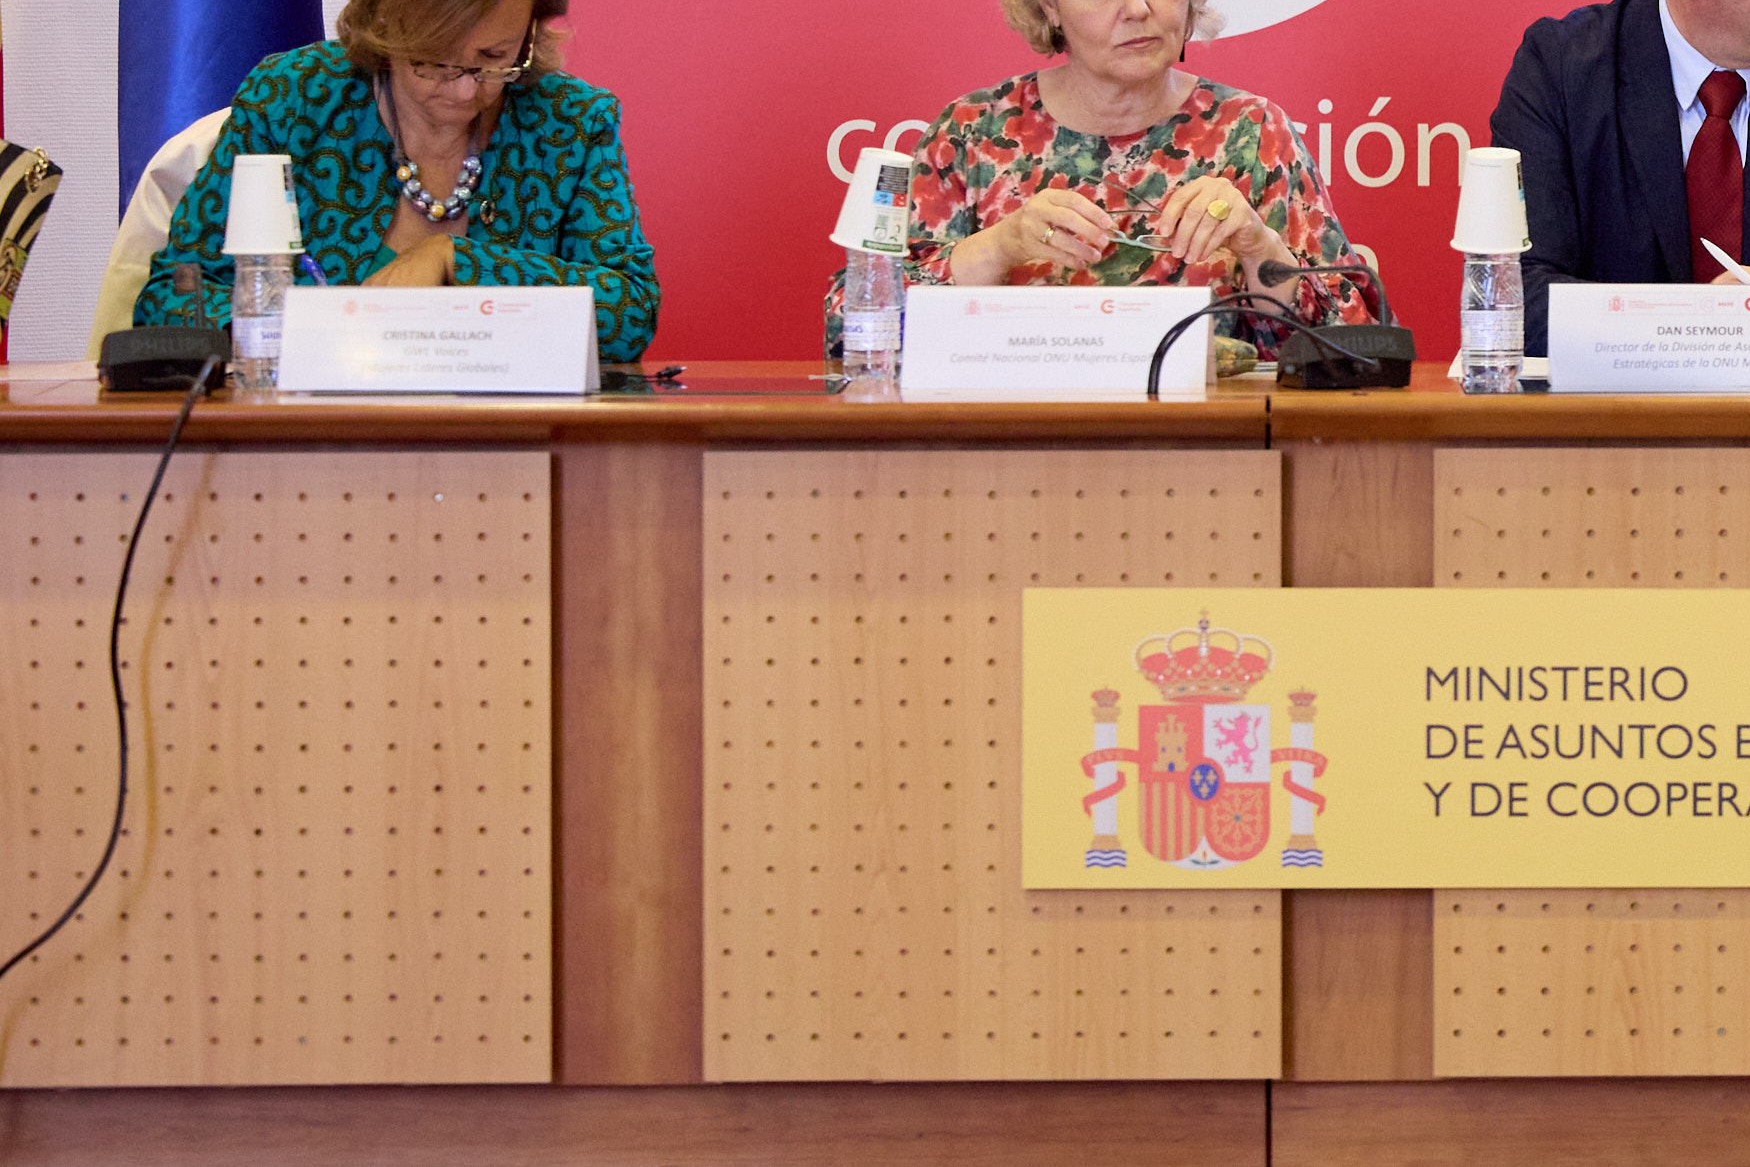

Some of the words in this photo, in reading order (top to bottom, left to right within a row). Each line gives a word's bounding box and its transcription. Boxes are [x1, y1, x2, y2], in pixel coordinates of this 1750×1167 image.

[1658, 327, 1682, 335] DAN
[1686, 327, 1743, 335] SEYMOUR
[1009, 338, 1047, 346] MARÍA
[1051, 337, 1104, 346] SOLANAS
[1595, 342, 1639, 352] Director
[1642, 342, 1655, 352] de
[1659, 341, 1669, 352] la
[1672, 341, 1715, 352] División
[1718, 341, 1731, 352] de
[1613, 358, 1679, 370] Estratégicas
[1683, 358, 1696, 368] de
[1700, 358, 1709, 368] la
[1713, 358, 1739, 368] ONU
[1427, 666, 1688, 701] MINISTERIO
[1427, 725, 1483, 759] DE
[1496, 724, 1716, 759] ASUNTOS
[1425, 783, 1451, 816] Y
[1471, 783, 1528, 816] DE
